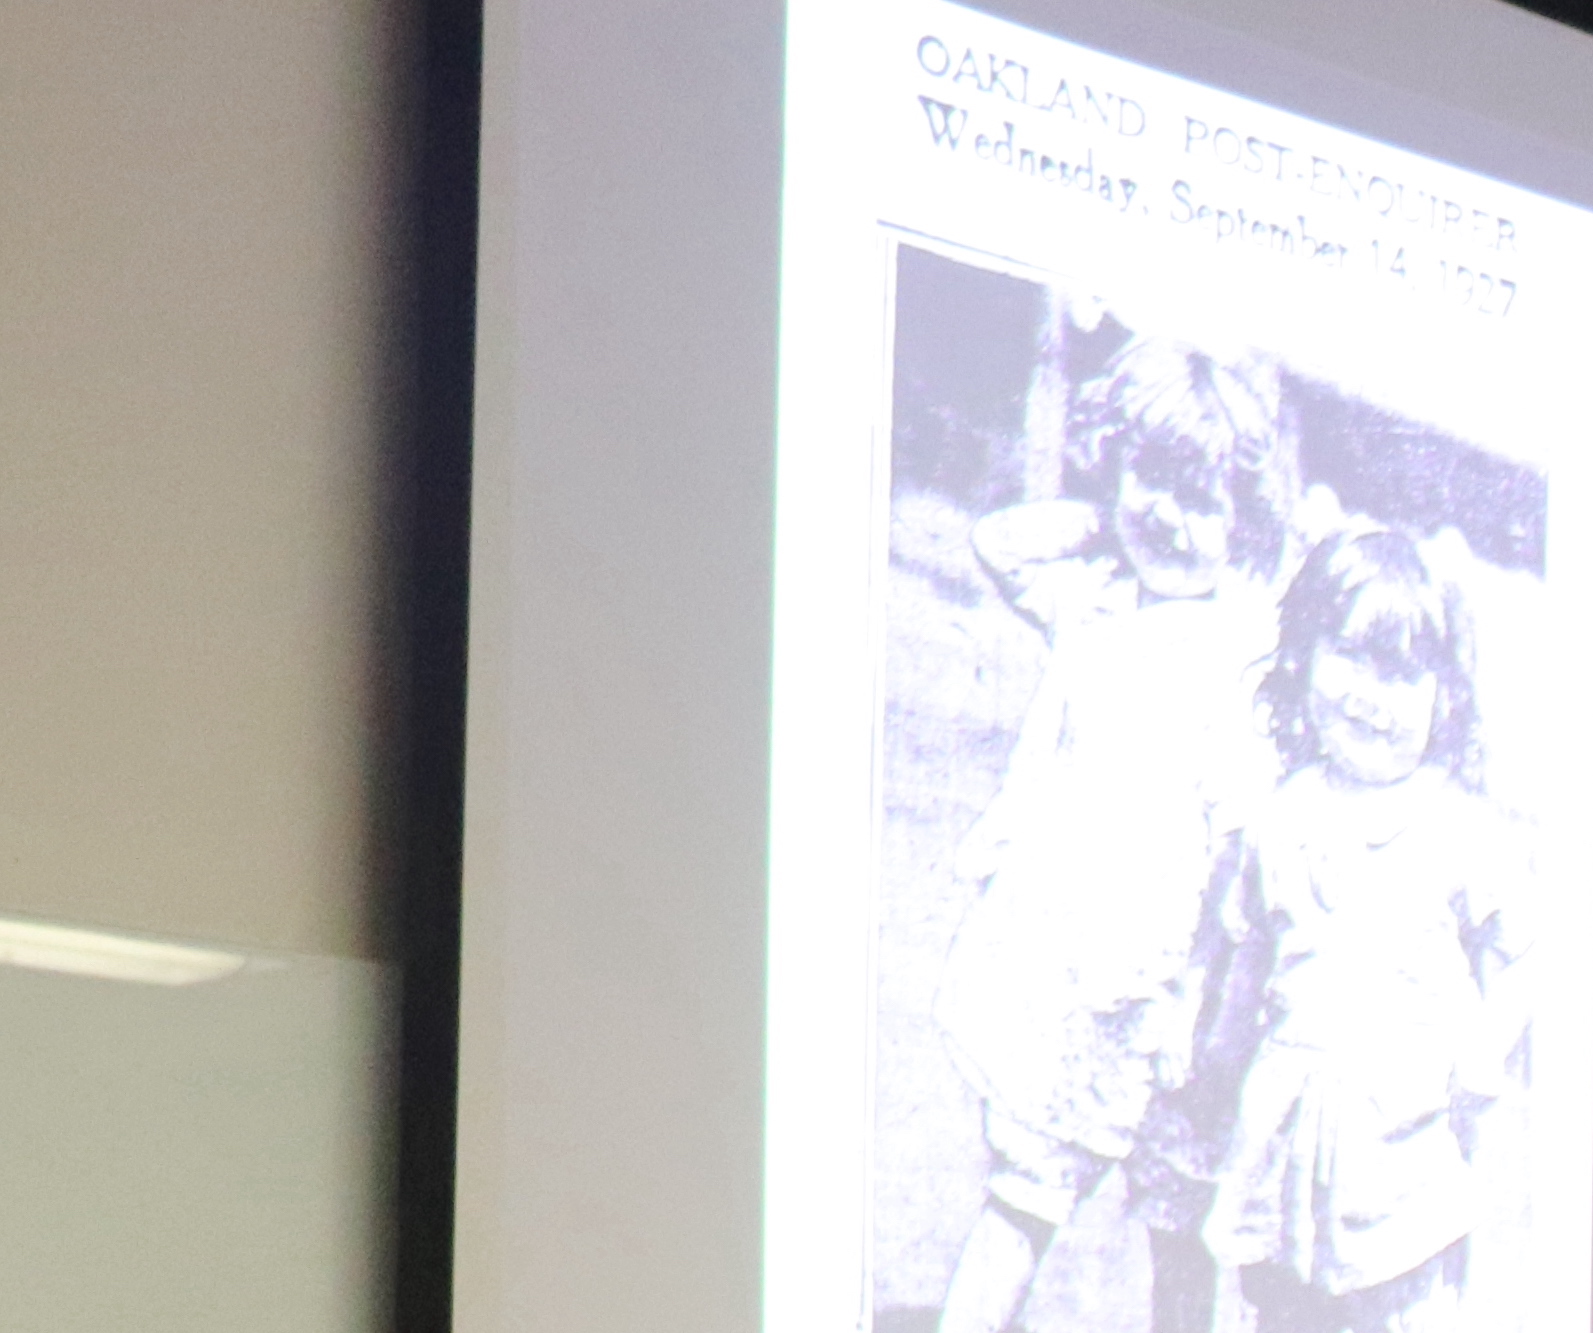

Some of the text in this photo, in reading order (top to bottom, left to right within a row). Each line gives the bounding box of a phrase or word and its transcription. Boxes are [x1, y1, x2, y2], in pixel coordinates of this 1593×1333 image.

[916, 34, 1148, 138] OAKLAND
[916, 94, 1150, 216] Wednesday,
[1169, 179, 1350, 270] September
[1439, 260, 1519, 319] 1927
